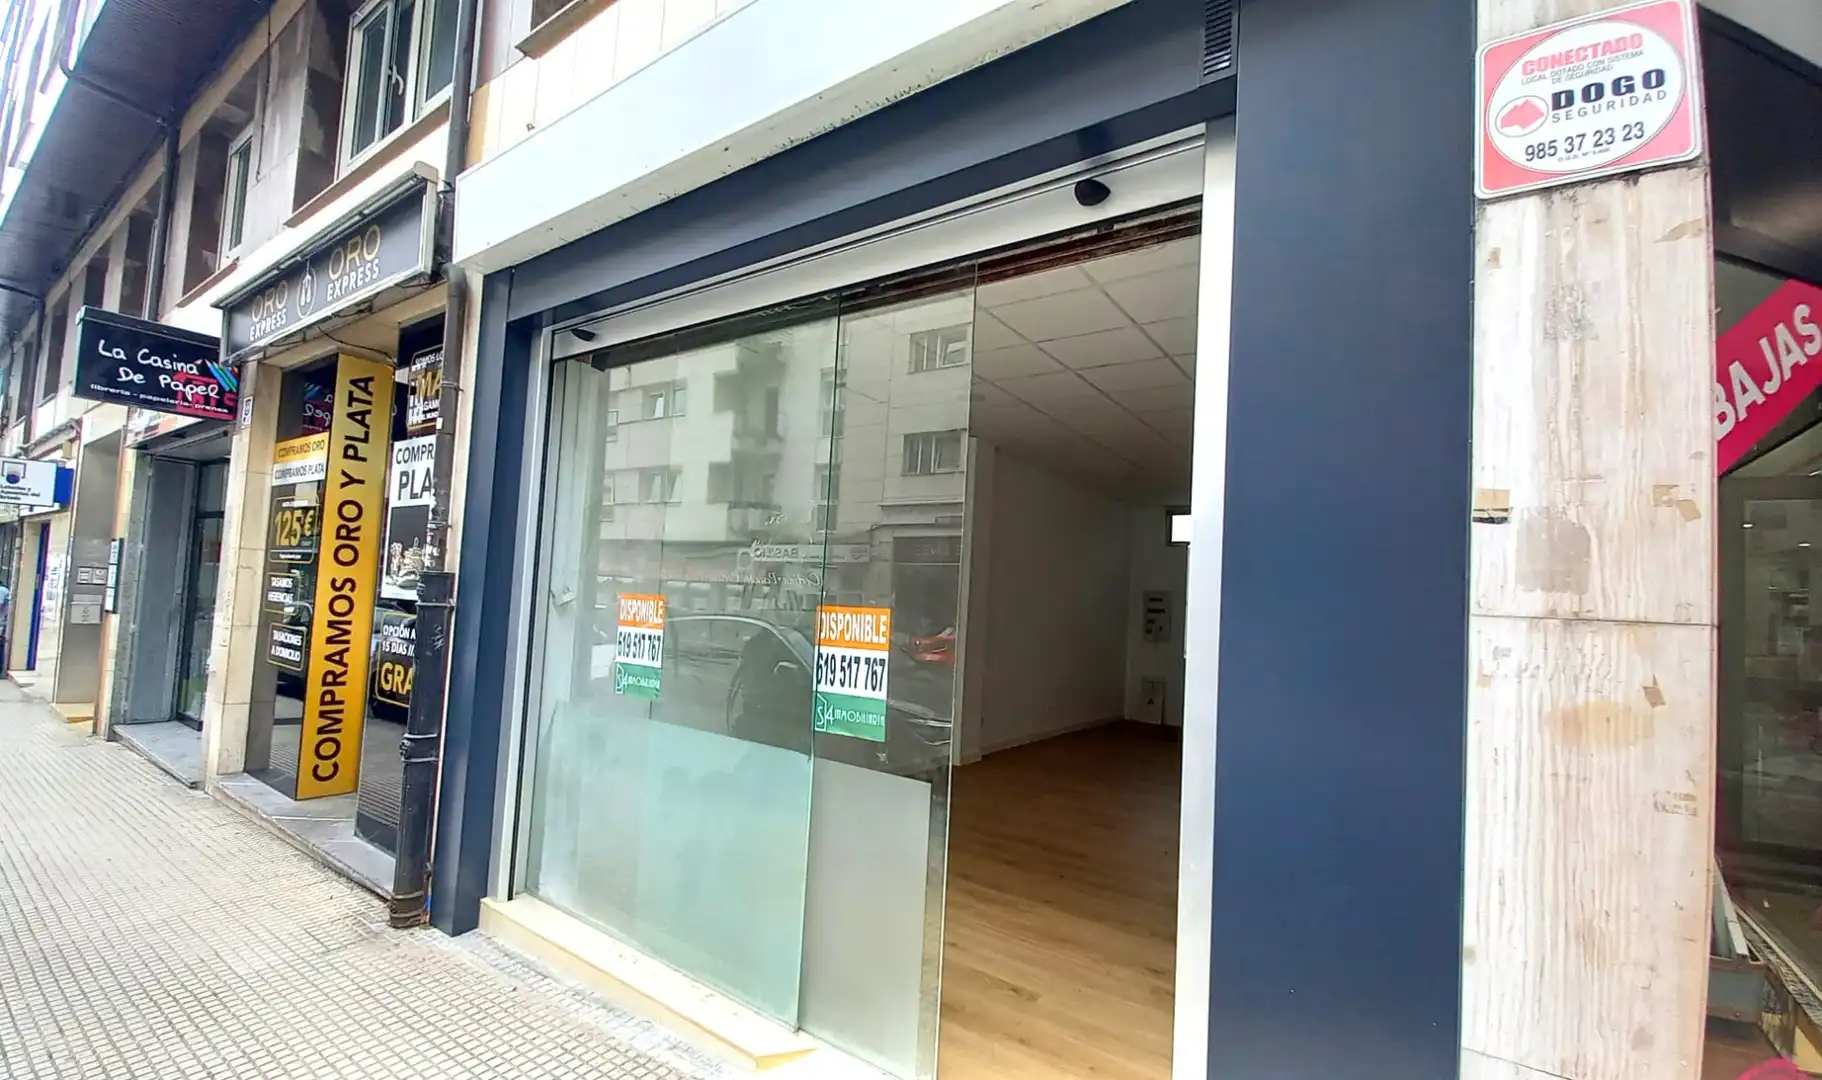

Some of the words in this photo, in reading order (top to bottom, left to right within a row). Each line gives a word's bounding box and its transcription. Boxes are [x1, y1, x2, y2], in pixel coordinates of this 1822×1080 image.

[1521, 33, 1644, 76] CONECTADO
[1521, 73, 1547, 85] LOCAL
[1550, 65, 1585, 79] DOTADO
[1587, 59, 1605, 70] CON
[1607, 49, 1645, 64] SISTEMA
[1551, 68, 1666, 111] DOGO
[1552, 77, 1562, 85] DE
[1564, 64, 1613, 82] SEGURIDAD
[1552, 89, 1667, 124] SEGURIDAD
[1525, 139, 1558, 162] 985
[1564, 133, 1587, 154] 37
[1592, 127, 1615, 149] 23
[1622, 121, 1645, 142] 23
[329, 224, 382, 280] ORO
[326, 258, 380, 302] EXPRESS
[251, 280, 289, 322] ORO
[249, 308, 287, 342] EXPRESS
[98, 339, 127, 360] La
[137, 348, 199, 375] Casina
[117, 367, 146, 384] De
[158, 374, 220, 401] Papel
[343, 376, 376, 463] PLATA
[278, 442, 311, 459] COMPRAMOS
[312, 439, 325, 452] ORO
[274, 467, 307, 481] COMPRAMOS
[308, 462, 325, 476] PLATA
[340, 469, 366, 489] Y
[334, 500, 363, 567] ORO
[620, 598, 664, 624] DISPONIBLE
[817, 611, 887, 644] DISPONIBLE
[618, 631, 631, 658] 619
[633, 633, 646, 660] 517
[648, 634, 662, 662] 767
[312, 578, 356, 782] COMPRAMOS
[816, 652, 836, 687] 619
[840, 655, 860, 689] 517
[865, 657, 886, 692] 767
